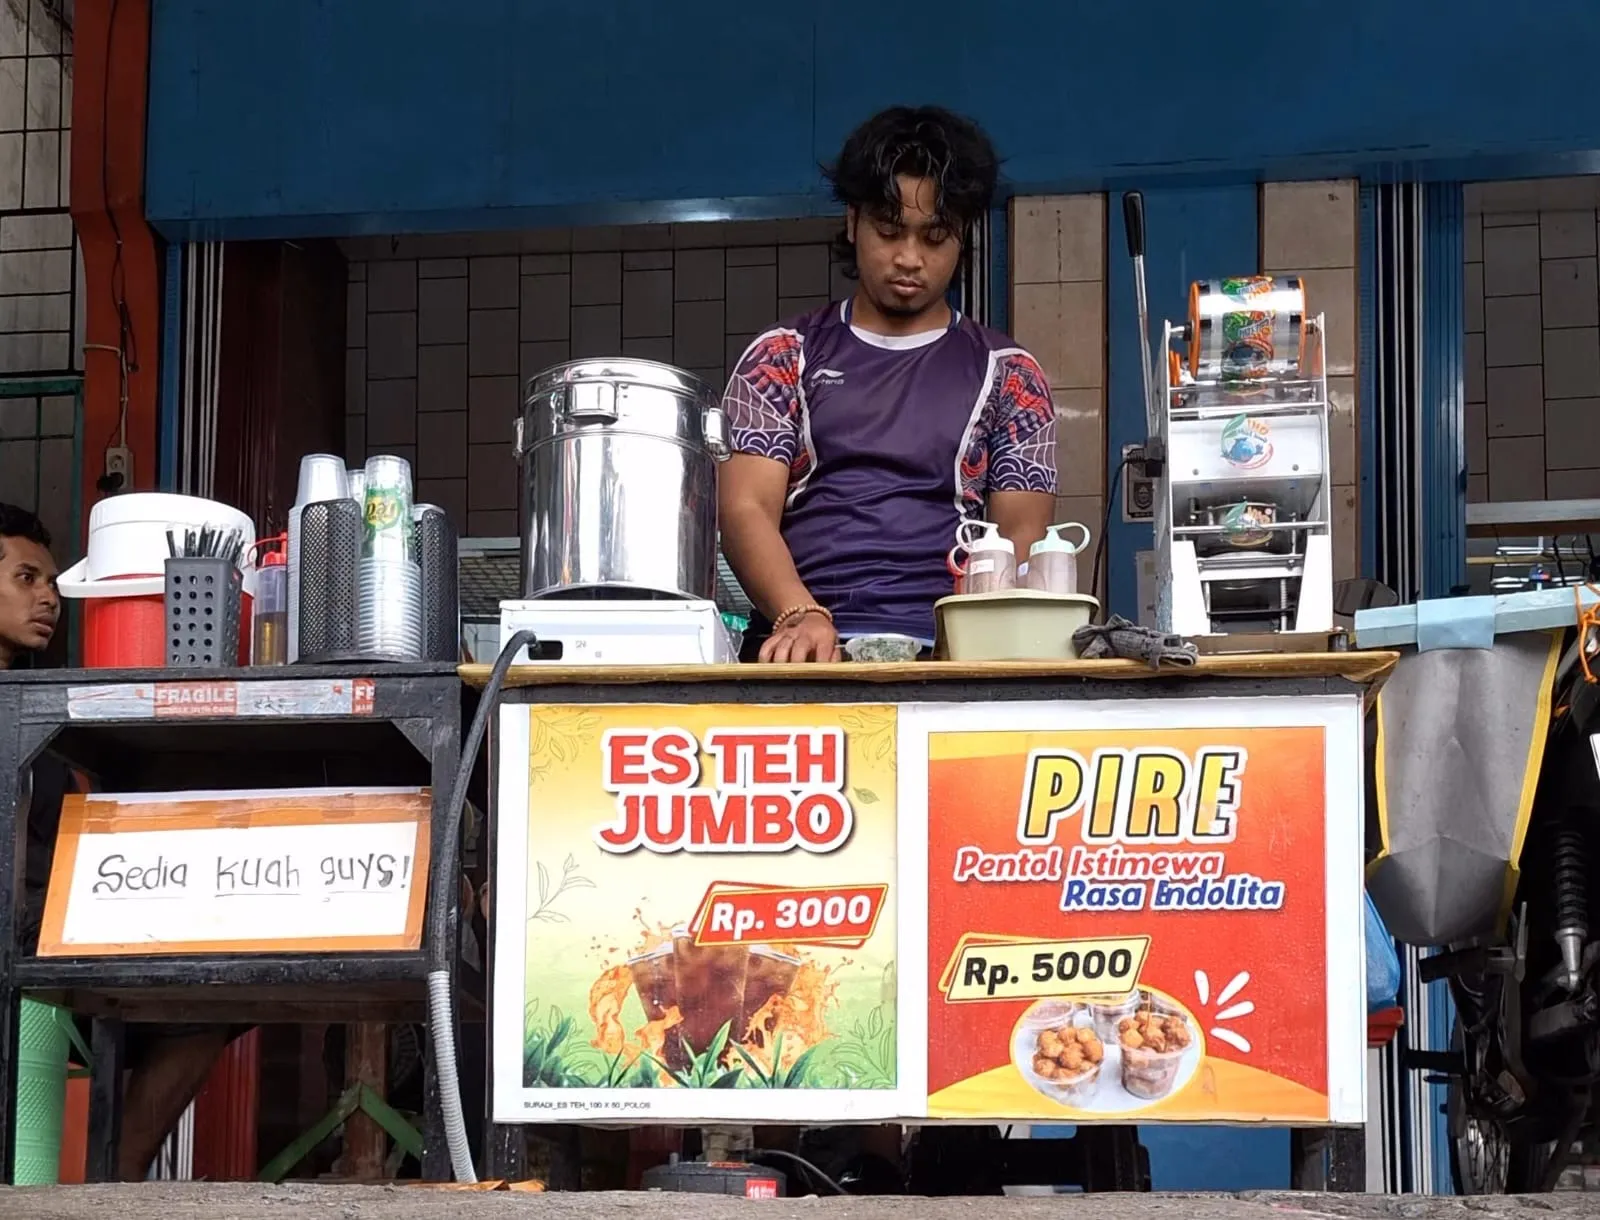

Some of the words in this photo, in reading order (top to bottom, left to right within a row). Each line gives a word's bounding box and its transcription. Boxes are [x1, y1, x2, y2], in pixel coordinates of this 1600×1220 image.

[156, 684, 236, 704] FRAGILE
[605, 732, 695, 786] ES
[708, 732, 840, 785] TEH
[1023, 751, 1240, 838] PIRE
[598, 792, 846, 846] JUMBO
[92, 854, 188, 894] Sedia
[319, 853, 411, 889] guys!
[956, 849, 1059, 878] Pentol
[1070, 848, 1221, 878] Istimewa
[1063, 879, 1142, 907] Rasa
[1153, 877, 1281, 906] Endolita
[710, 902, 765, 941] Rp.
[774, 894, 872, 929] 3000
[963, 956, 1019, 996] Rp.
[1031, 948, 1133, 983] 5000
